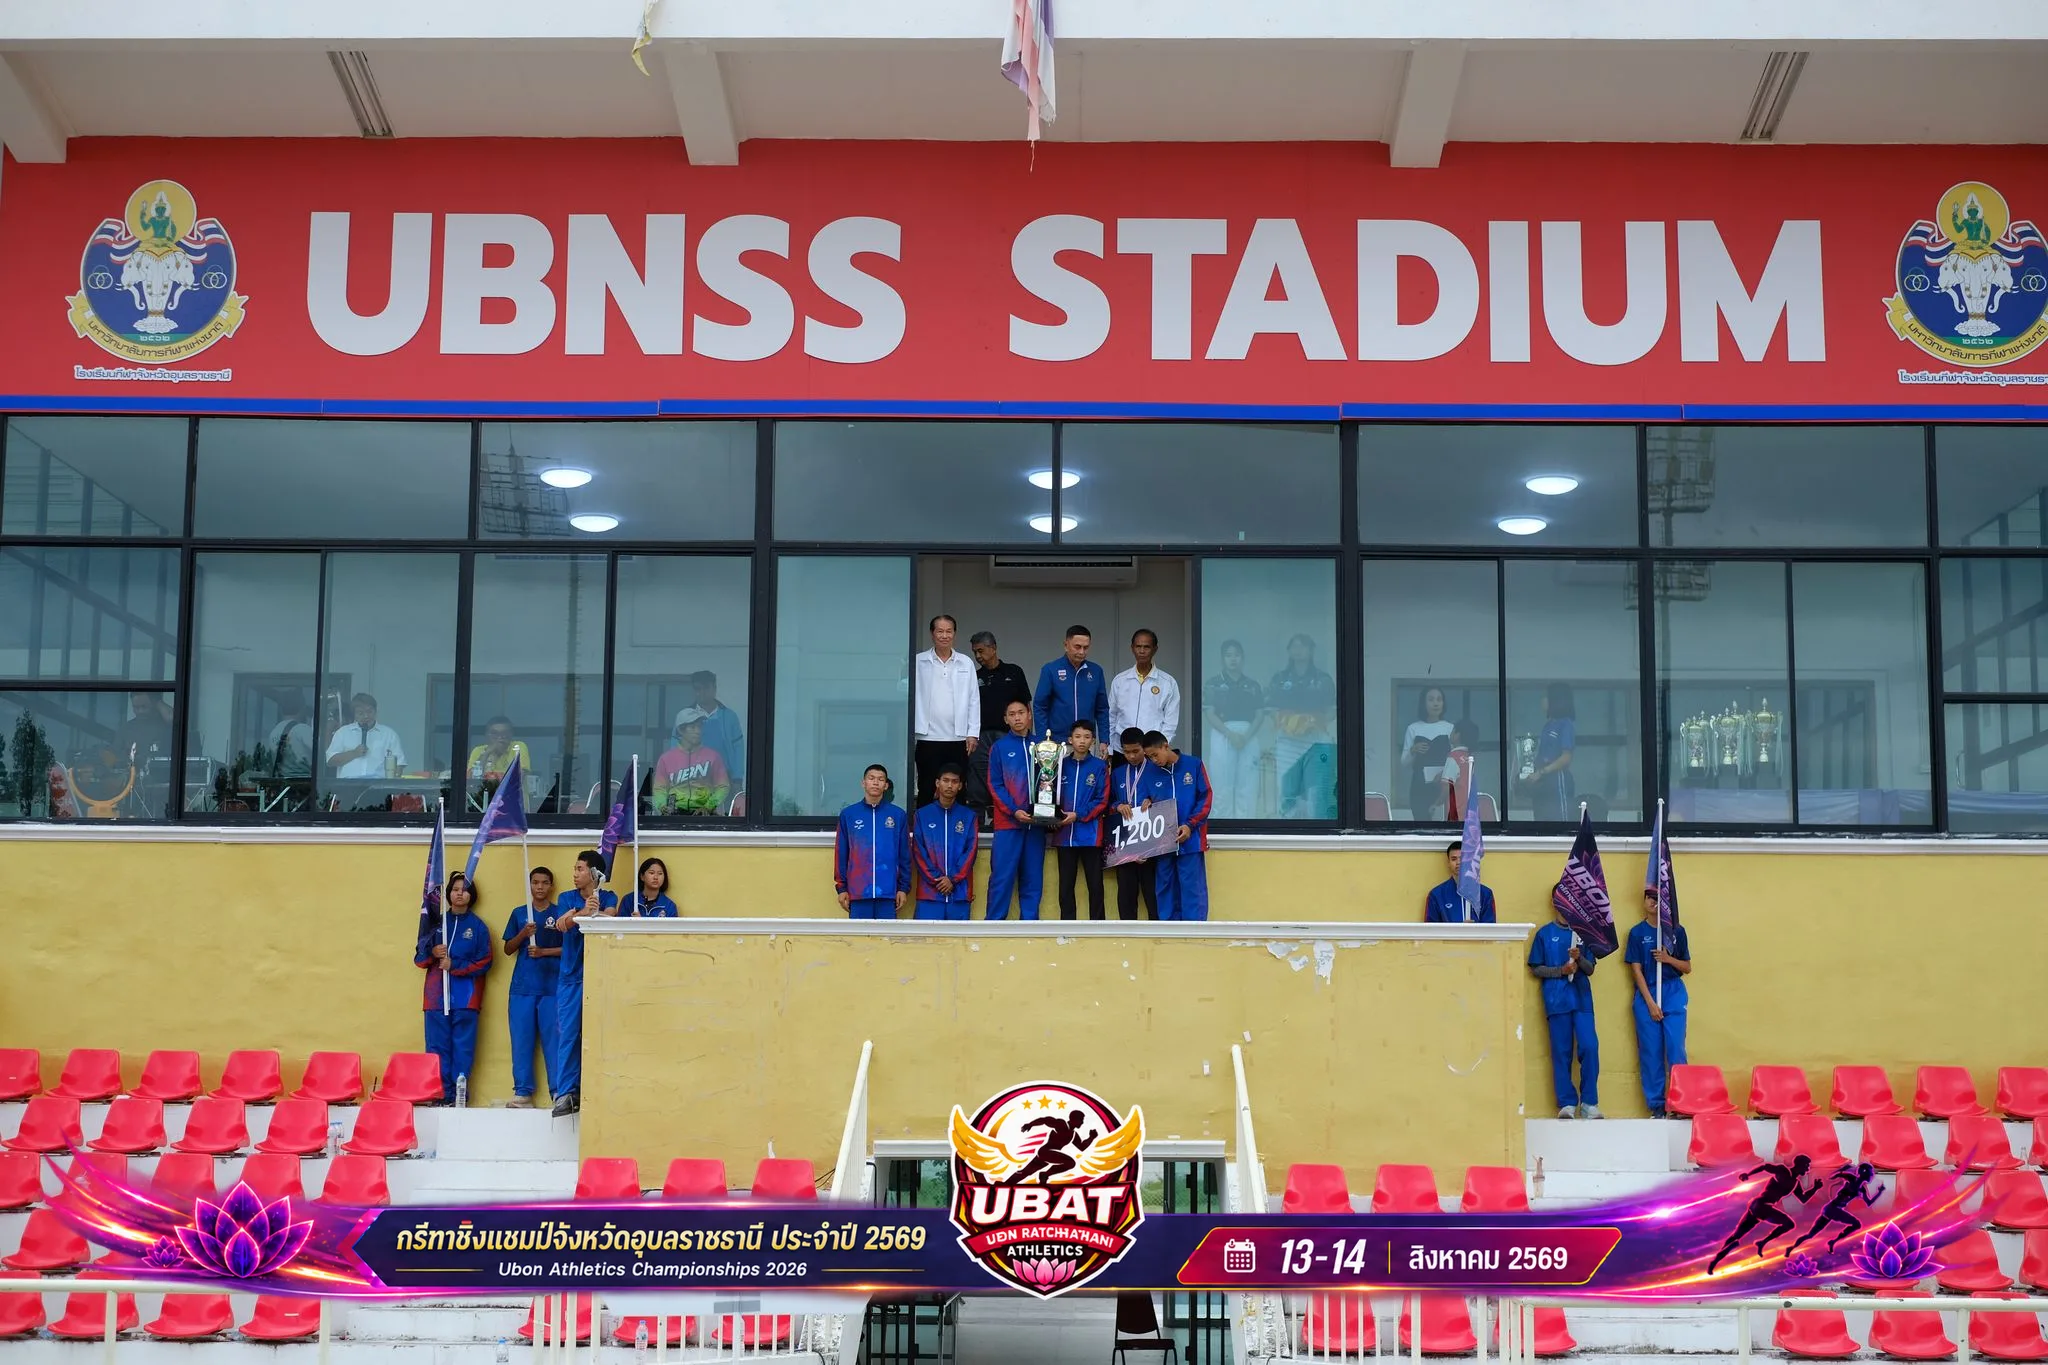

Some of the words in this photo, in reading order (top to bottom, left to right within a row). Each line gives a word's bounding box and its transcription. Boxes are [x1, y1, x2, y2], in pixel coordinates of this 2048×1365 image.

[307, 211, 907, 364] UBNSS
[1009, 214, 1826, 365] STADIUM
[1112, 815, 1165, 850] 1,200
